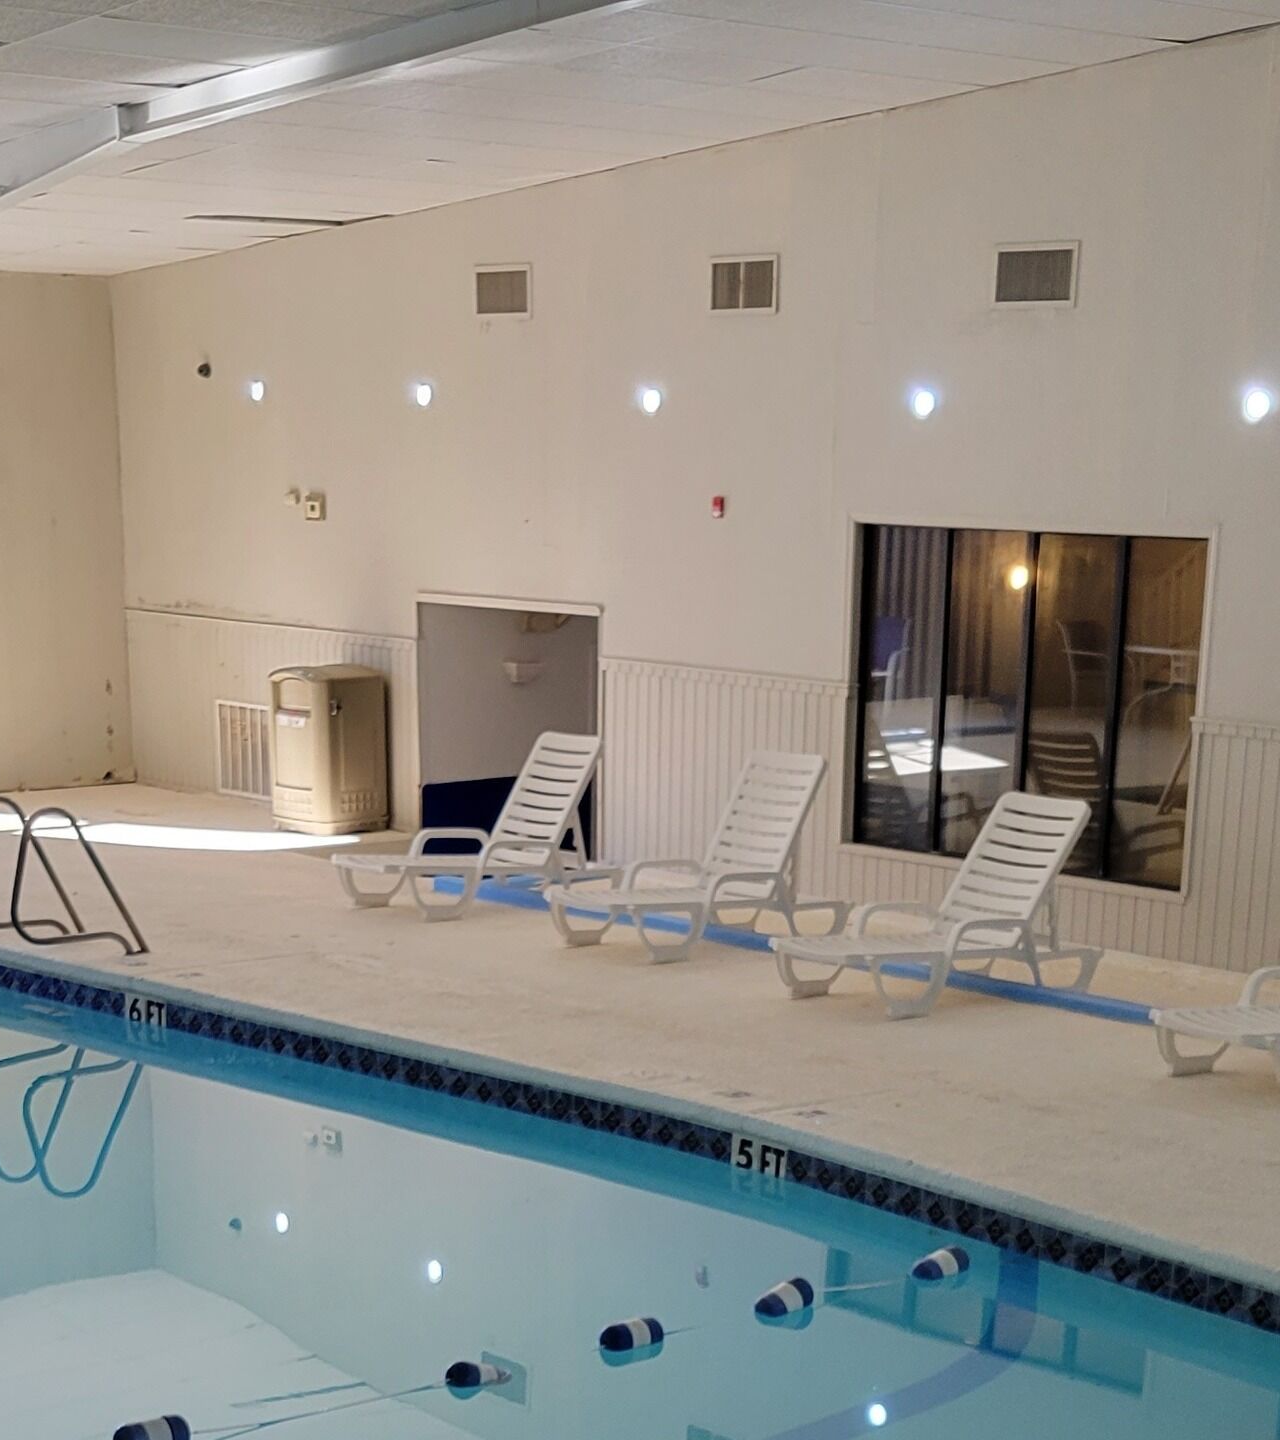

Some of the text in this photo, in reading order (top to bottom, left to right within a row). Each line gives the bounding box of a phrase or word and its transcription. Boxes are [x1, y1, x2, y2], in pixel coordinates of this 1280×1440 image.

[129, 998, 165, 1026] 6 FT
[735, 1138, 785, 1179] 5 FT
